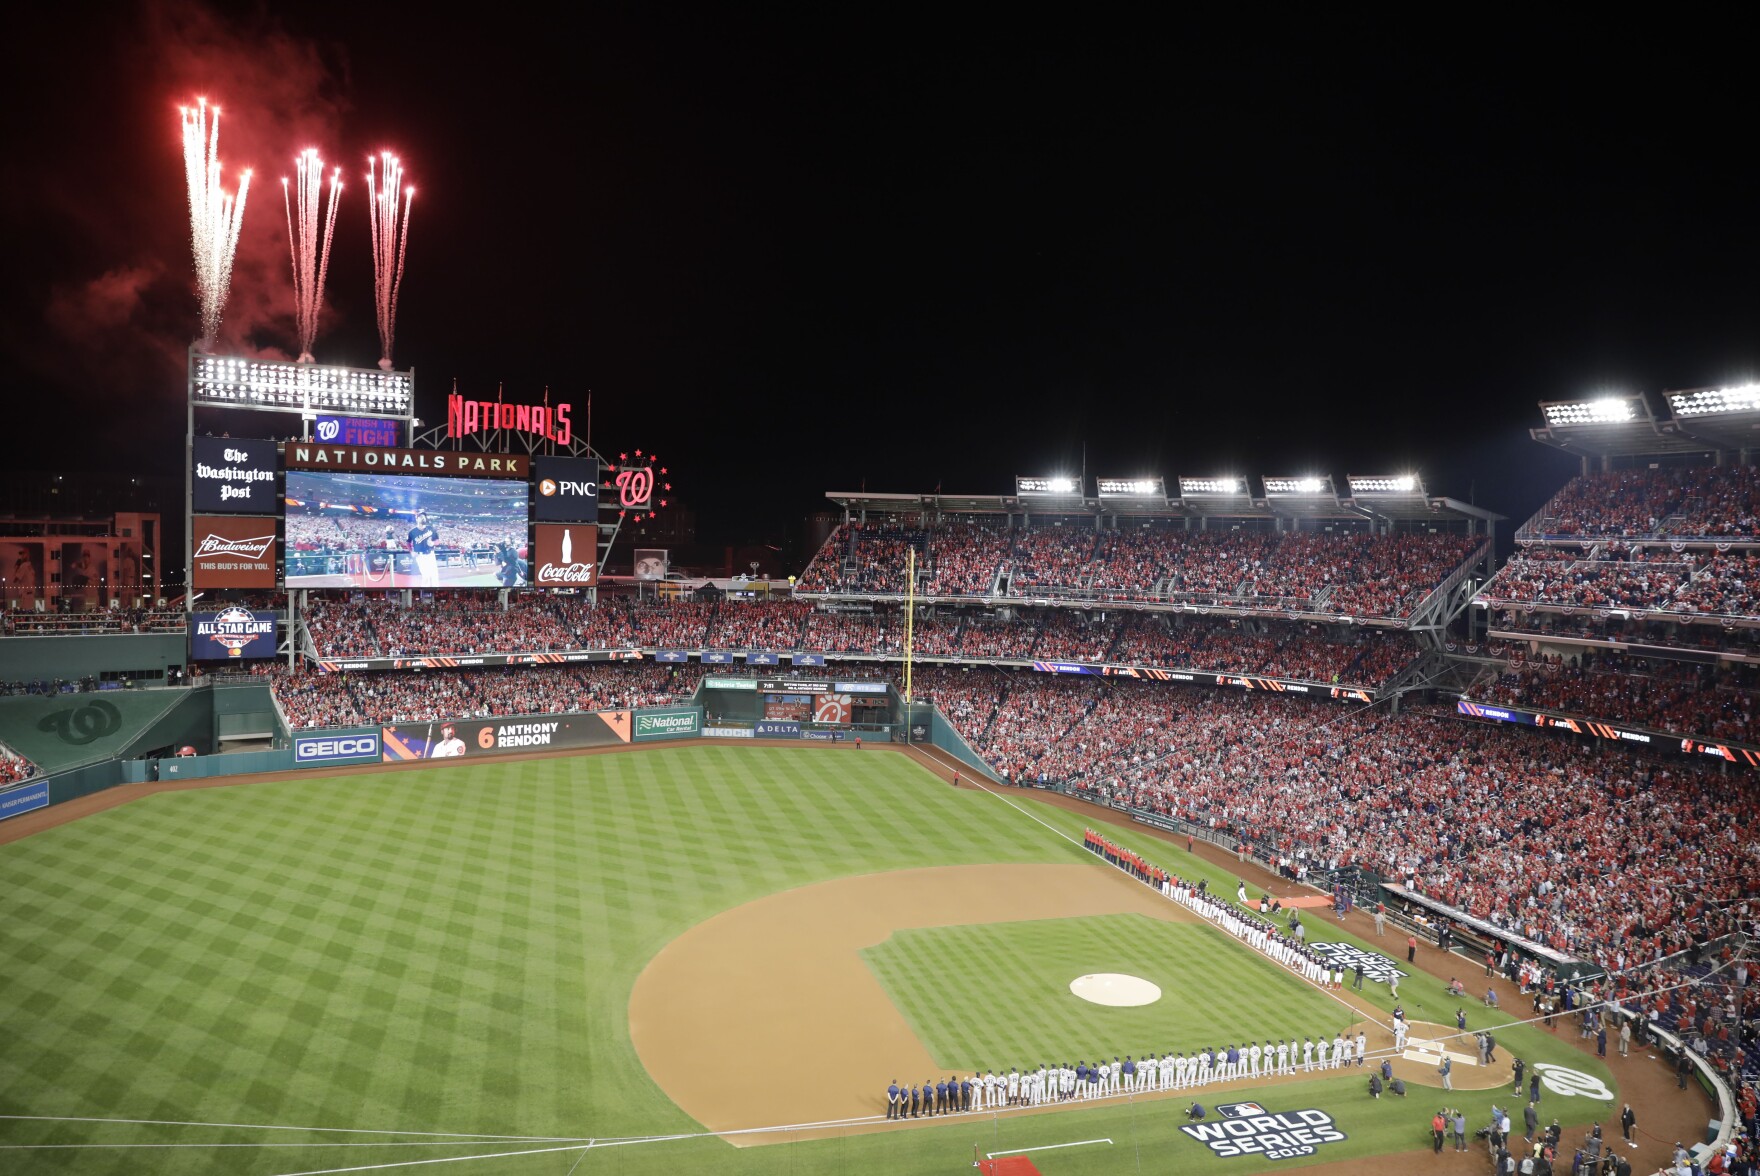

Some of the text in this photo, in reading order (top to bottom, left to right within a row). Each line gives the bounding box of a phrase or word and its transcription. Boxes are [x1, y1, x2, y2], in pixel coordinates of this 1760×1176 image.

[346, 418, 400, 430] FINISH THE
[448, 394, 571, 445] NATIONALS
[345, 430, 400, 446] FIGHT
[224, 448, 248, 463] The
[296, 448, 518, 472] NATIONALS PARK
[196, 462, 274, 482] Washington
[220, 485, 252, 500] Post
[559, 481, 596, 496] PNC
[200, 539, 266, 552] Budweiser
[197, 622, 272, 635] ALL STAR GAME
[652, 715, 694, 728] National
[478, 722, 558, 748] 6 ANTHONY
[716, 728, 750, 737] KOCH
[300, 738, 375, 756] GEICO
[498, 733, 551, 748] RENDON
[2, 800, 17, 808] KAISER
[1182, 1109, 1332, 1141] WORLD
[1209, 1126, 1345, 1156] SERIES
[1266, 1145, 1314, 1159] 2019
